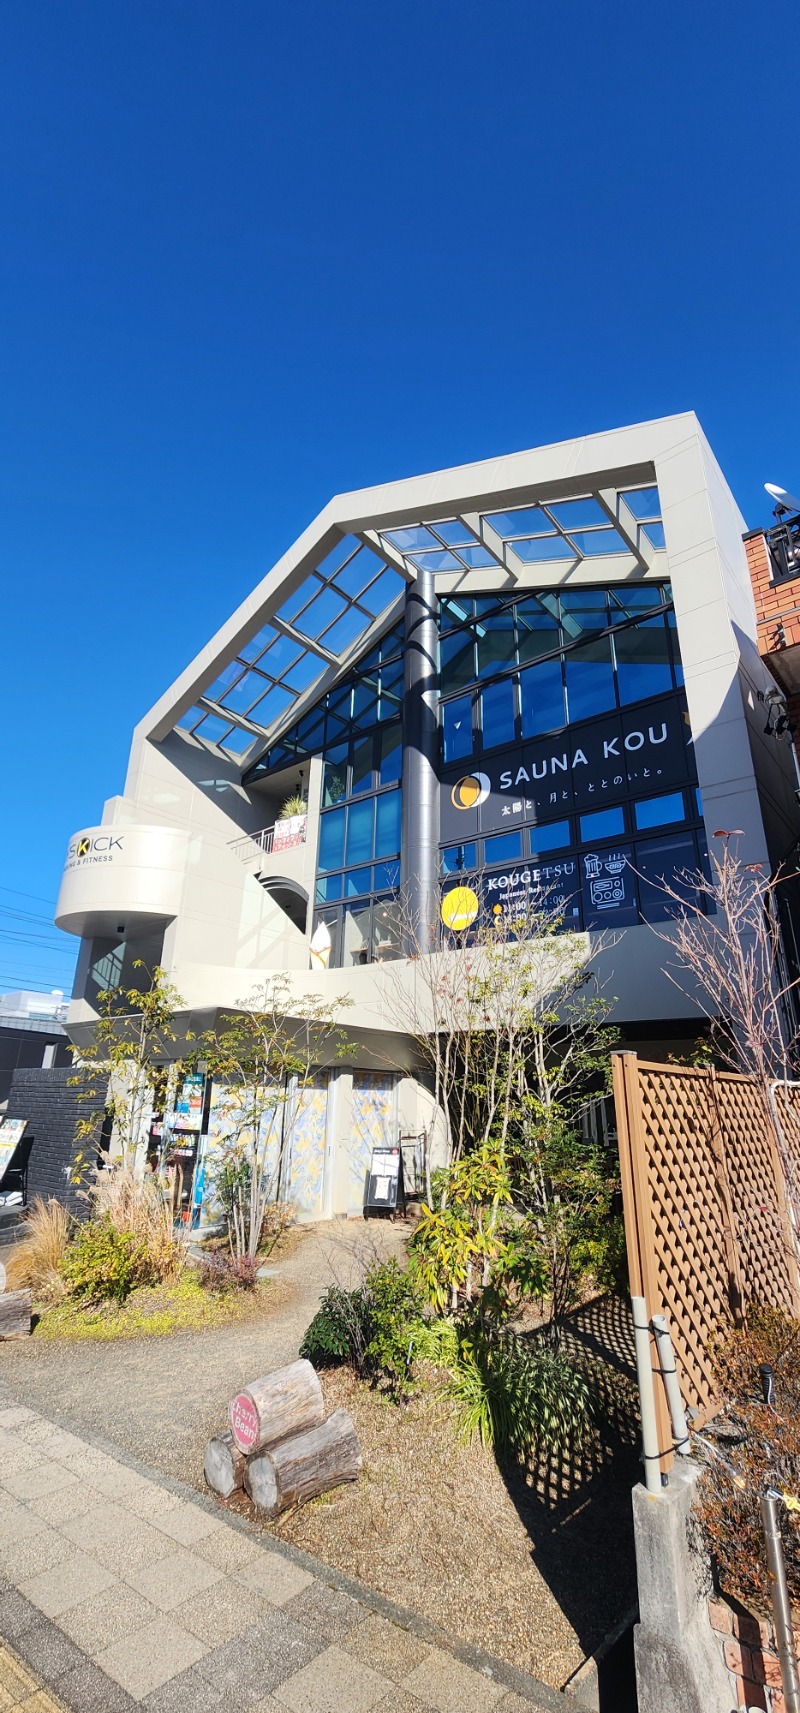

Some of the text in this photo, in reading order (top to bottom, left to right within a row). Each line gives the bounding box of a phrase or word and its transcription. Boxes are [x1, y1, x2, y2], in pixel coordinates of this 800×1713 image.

[499, 723, 668, 790] SAUNA KOU
[82, 855, 113, 864] FITNESS
[488, 862, 575, 891] KOUGETSU
